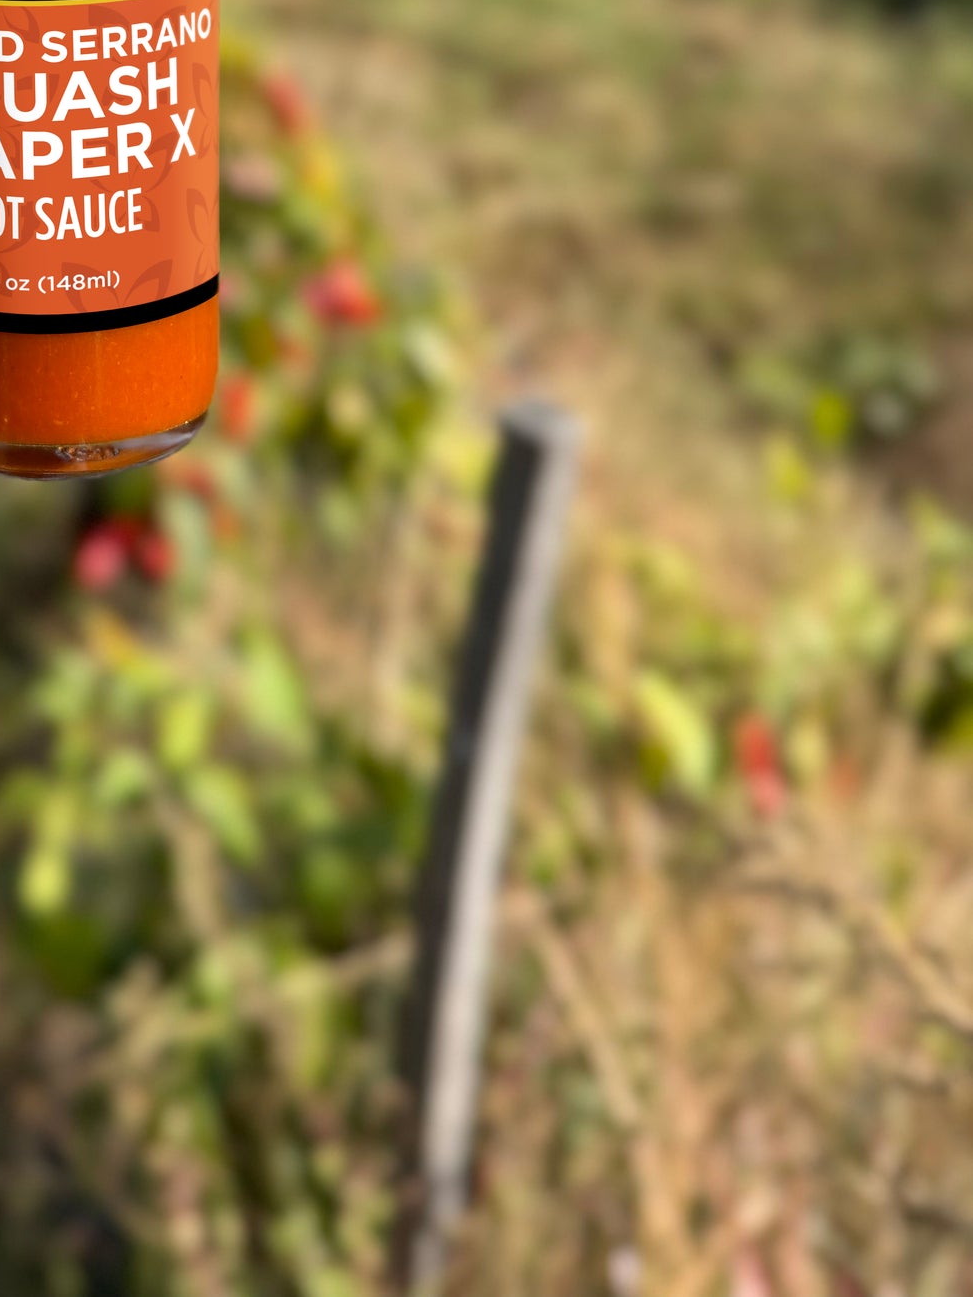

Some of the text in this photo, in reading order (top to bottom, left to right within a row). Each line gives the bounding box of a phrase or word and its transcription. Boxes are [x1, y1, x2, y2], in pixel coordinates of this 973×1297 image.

[40, 7, 212, 64] SERRANO
[169, 107, 197, 164] X
[35, 187, 144, 241] SAUCE
[5, 277, 30, 292] oz
[37, 270, 121, 294] (148ml)
